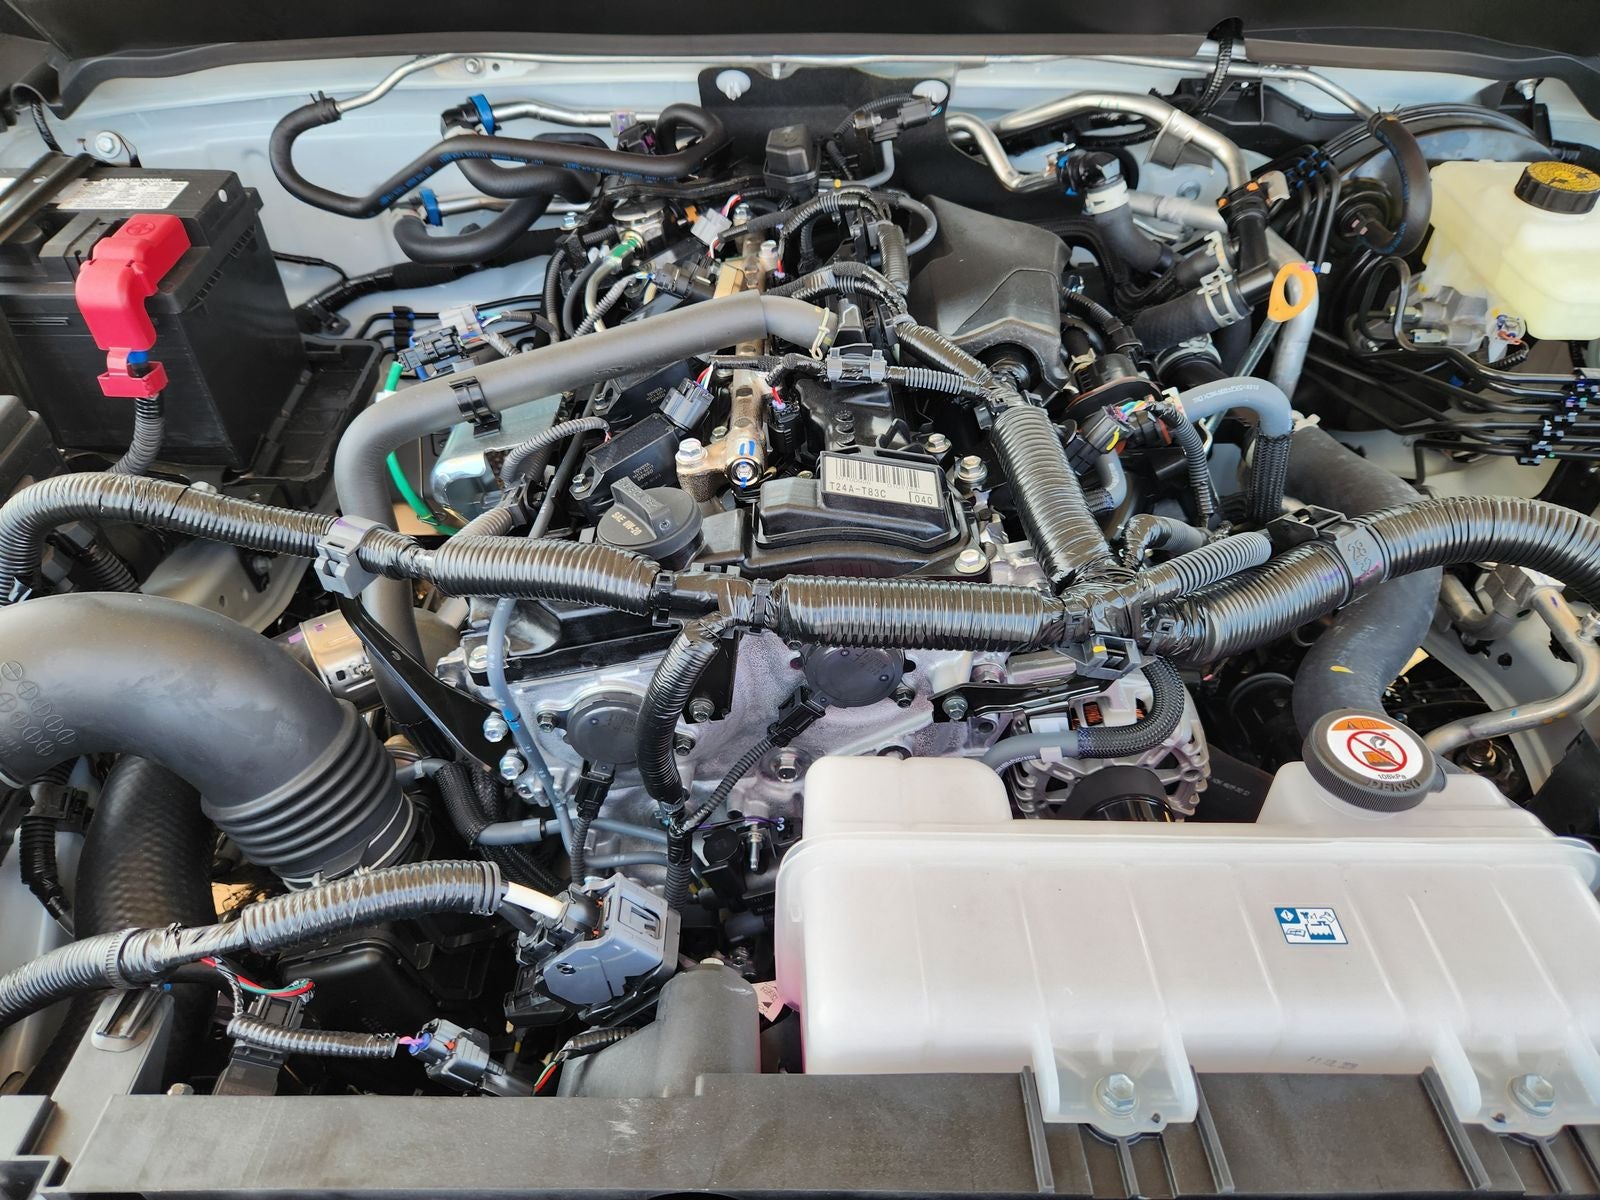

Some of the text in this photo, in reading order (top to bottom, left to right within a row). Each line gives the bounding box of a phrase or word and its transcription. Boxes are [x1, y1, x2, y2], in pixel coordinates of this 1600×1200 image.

[830, 481, 886, 498] T24A-T83C
[914, 494, 933, 505] 040
[611, 511, 626, 522] SAE
[1368, 779, 1421, 792] DENSO
